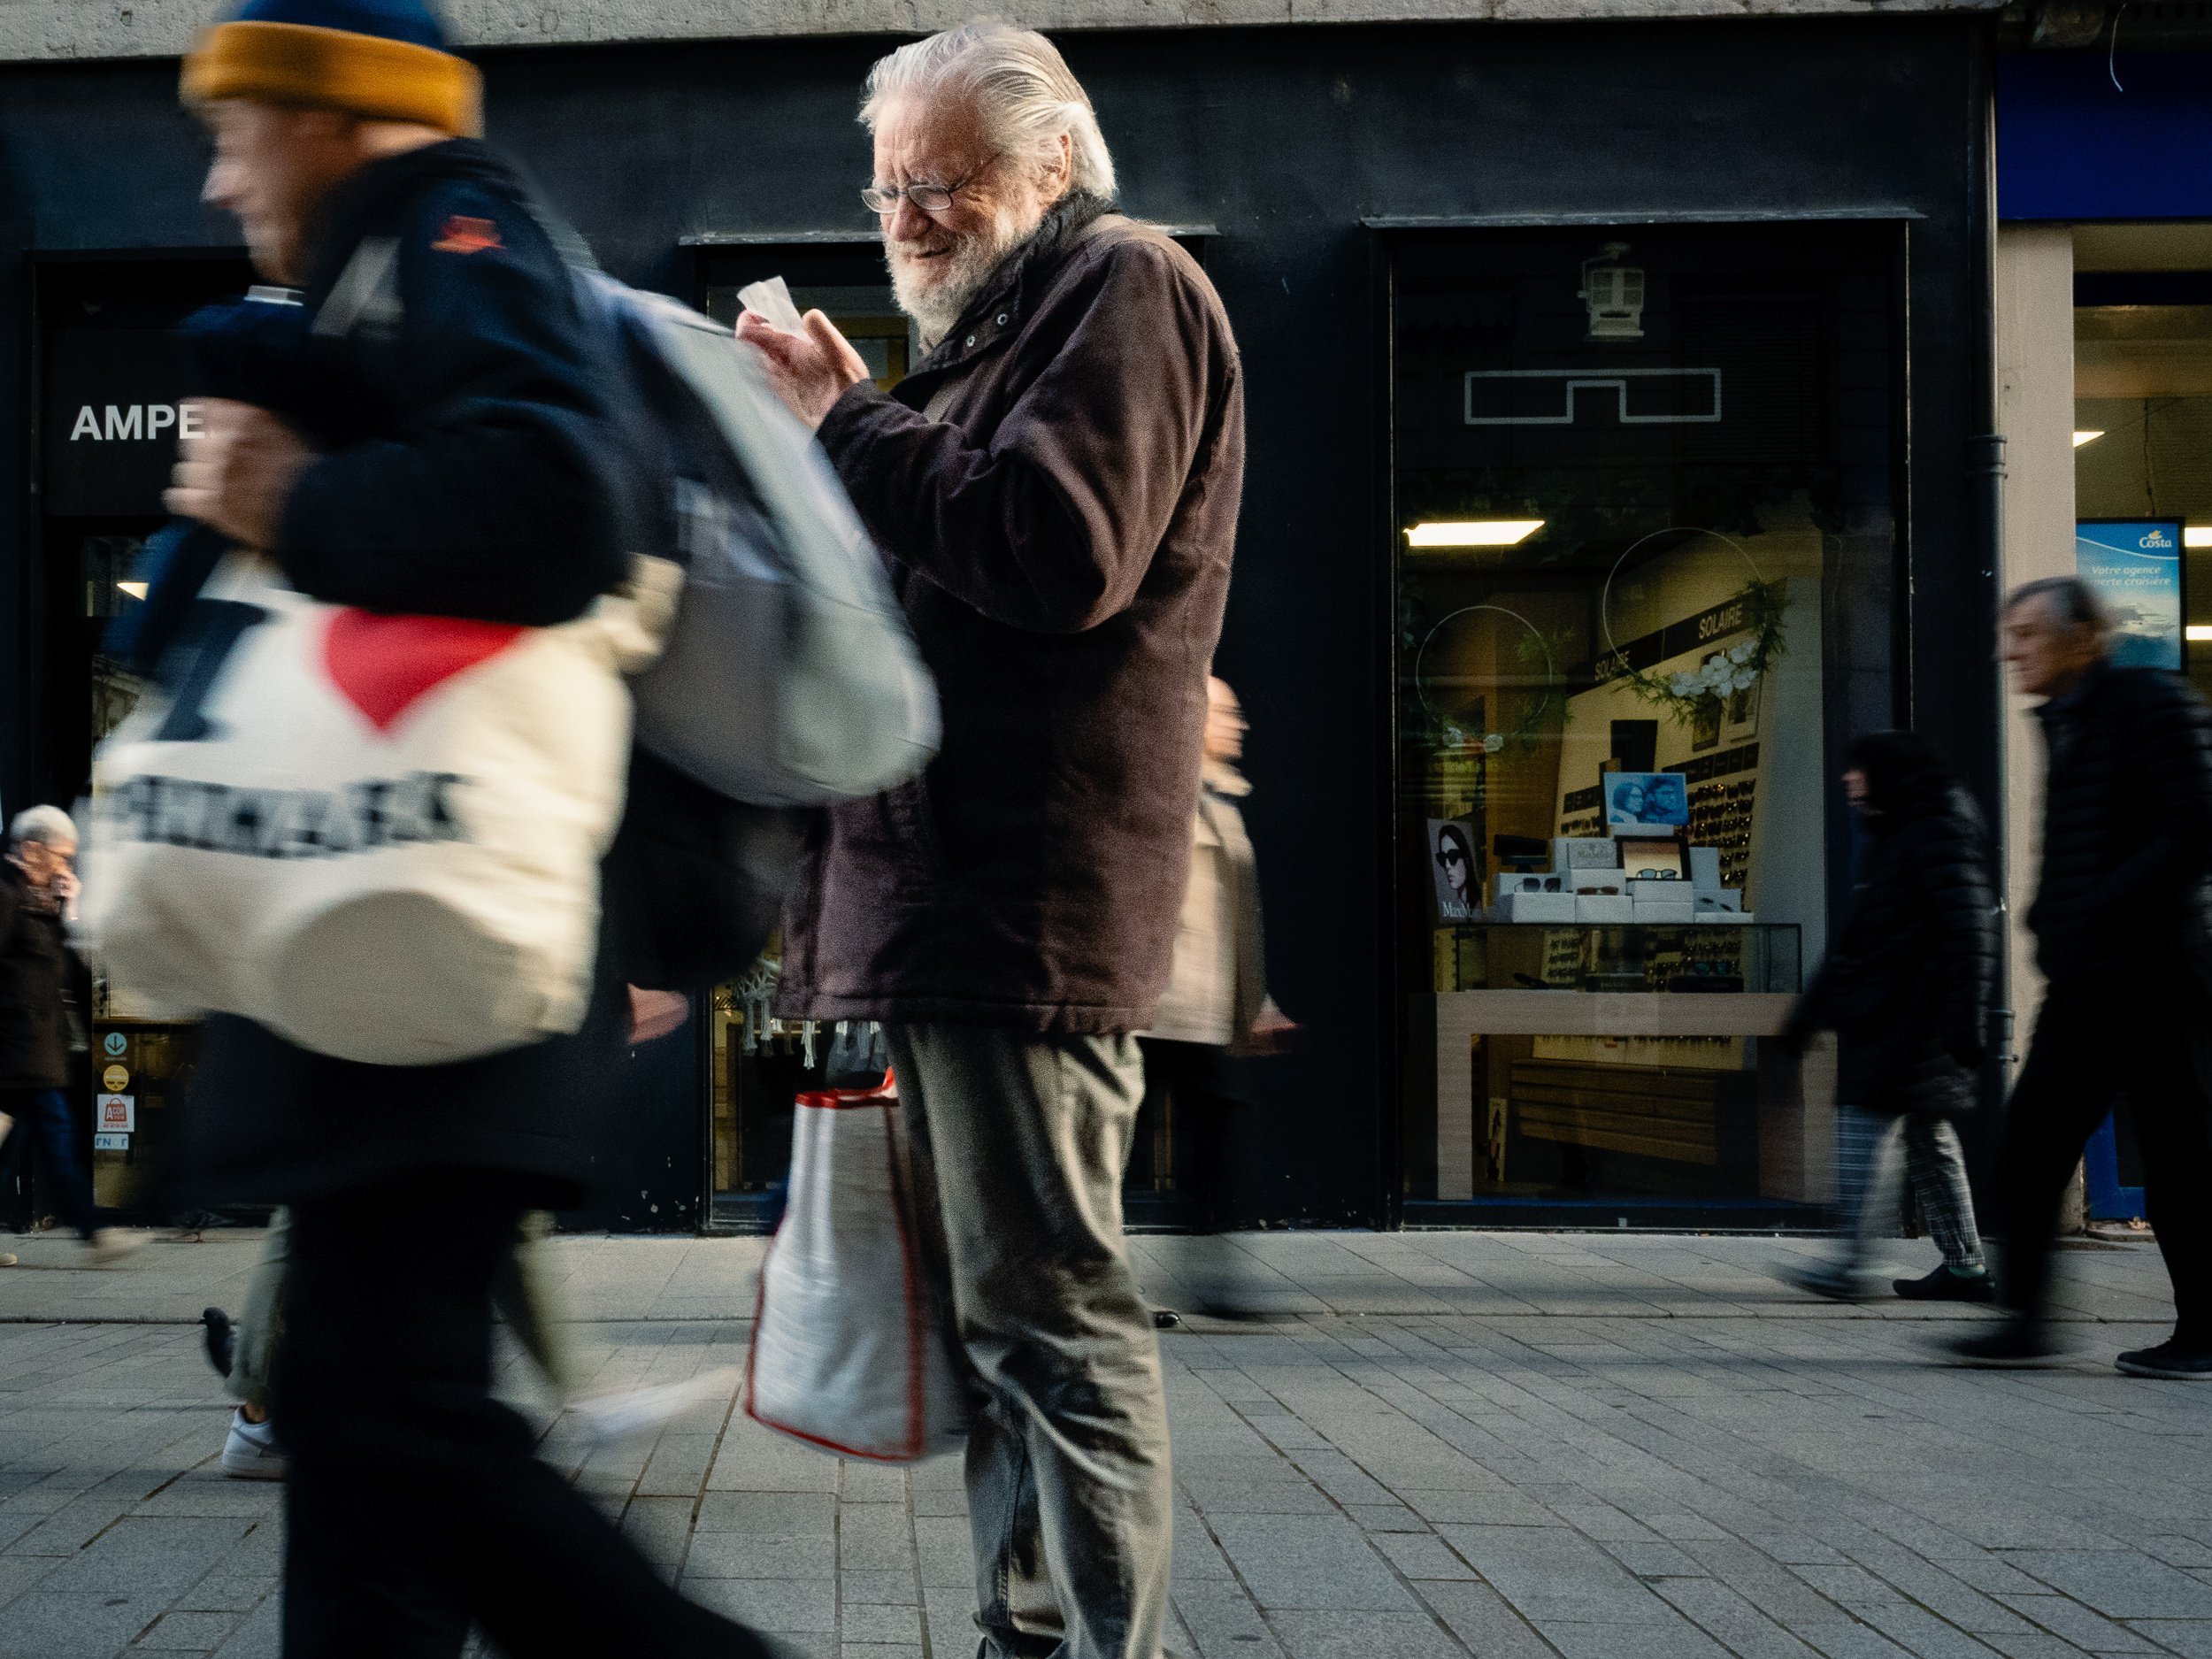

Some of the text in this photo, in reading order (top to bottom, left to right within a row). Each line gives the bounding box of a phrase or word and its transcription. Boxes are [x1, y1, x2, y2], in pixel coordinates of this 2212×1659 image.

[70, 404, 206, 441] AMPE
[2139, 536, 2172, 549] Costa
[1699, 603, 1742, 640] SOLAIRE
